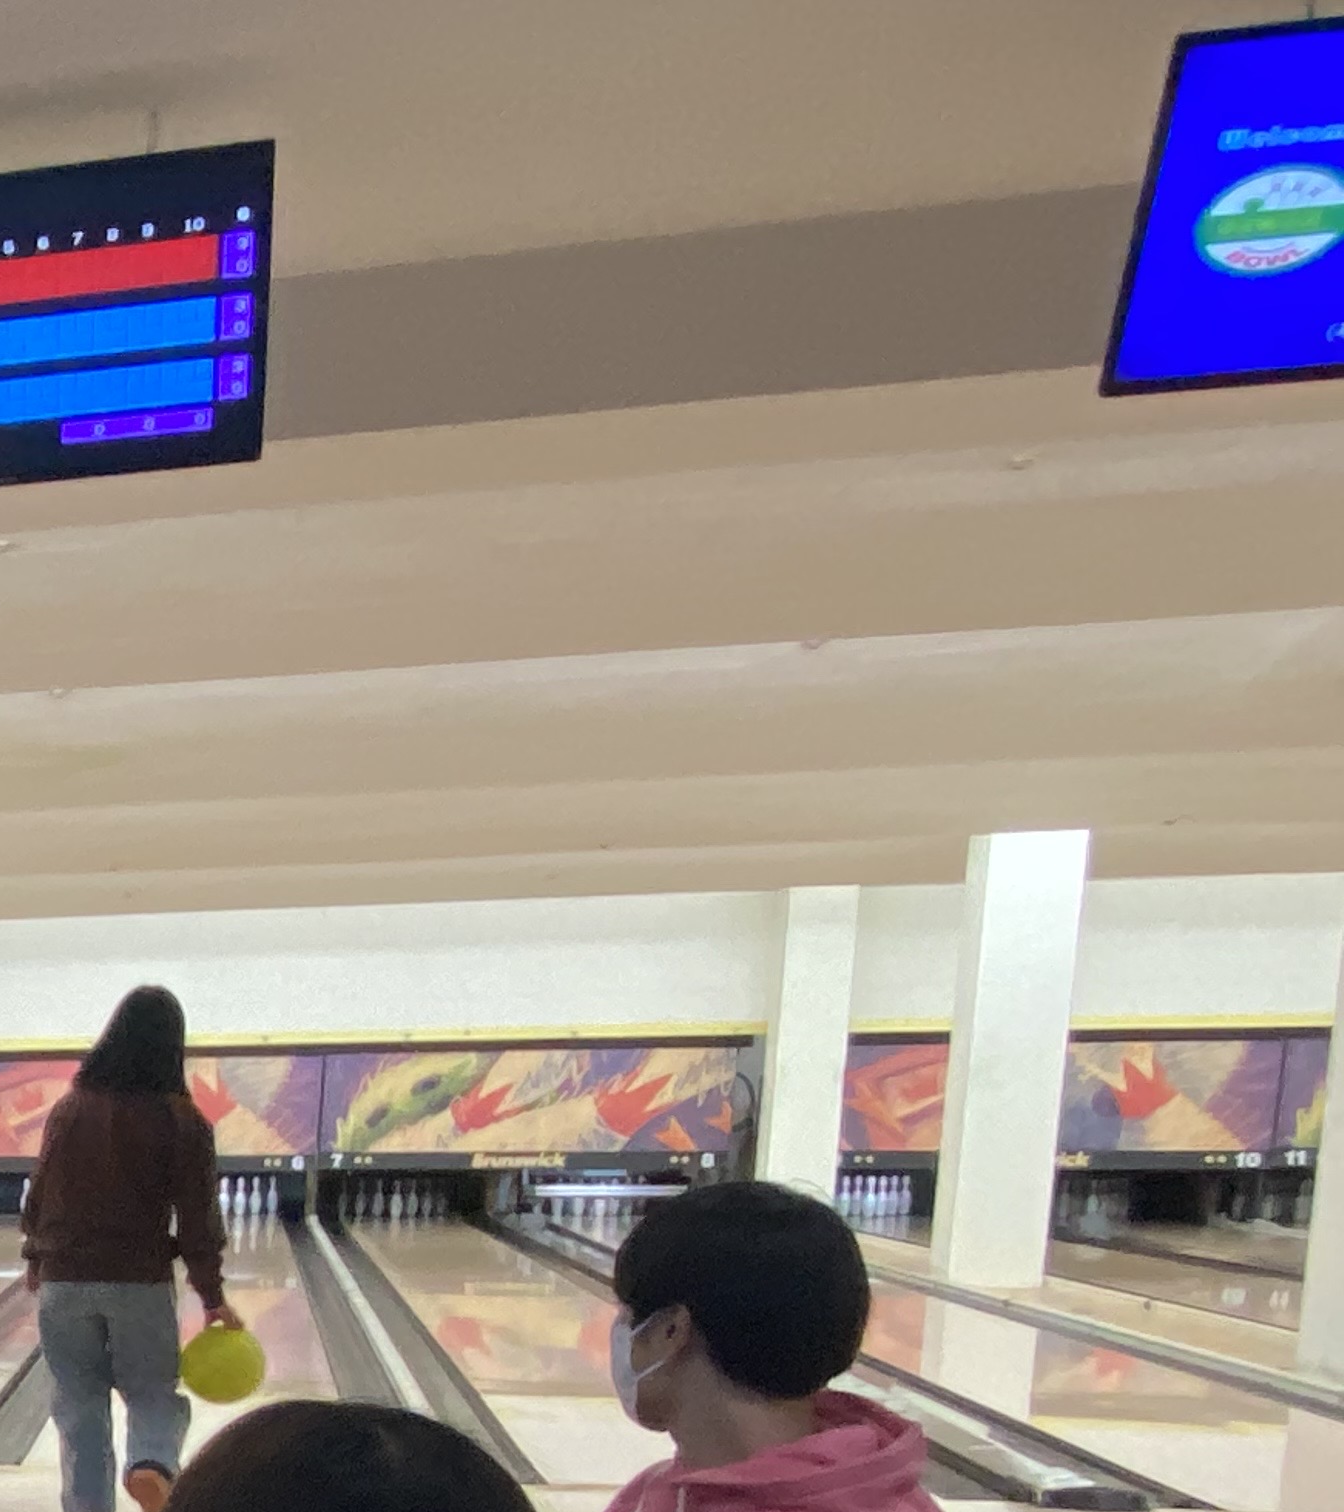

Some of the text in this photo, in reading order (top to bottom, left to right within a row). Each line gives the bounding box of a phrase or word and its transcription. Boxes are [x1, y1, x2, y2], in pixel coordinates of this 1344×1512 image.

[72, 231, 84, 246] 7
[184, 217, 205, 233] 10
[330, 1152, 344, 1168] 7
[471, 1152, 567, 1169] Brunswick
[1234, 1151, 1262, 1168] 10
[1284, 1149, 1308, 1166] 11
